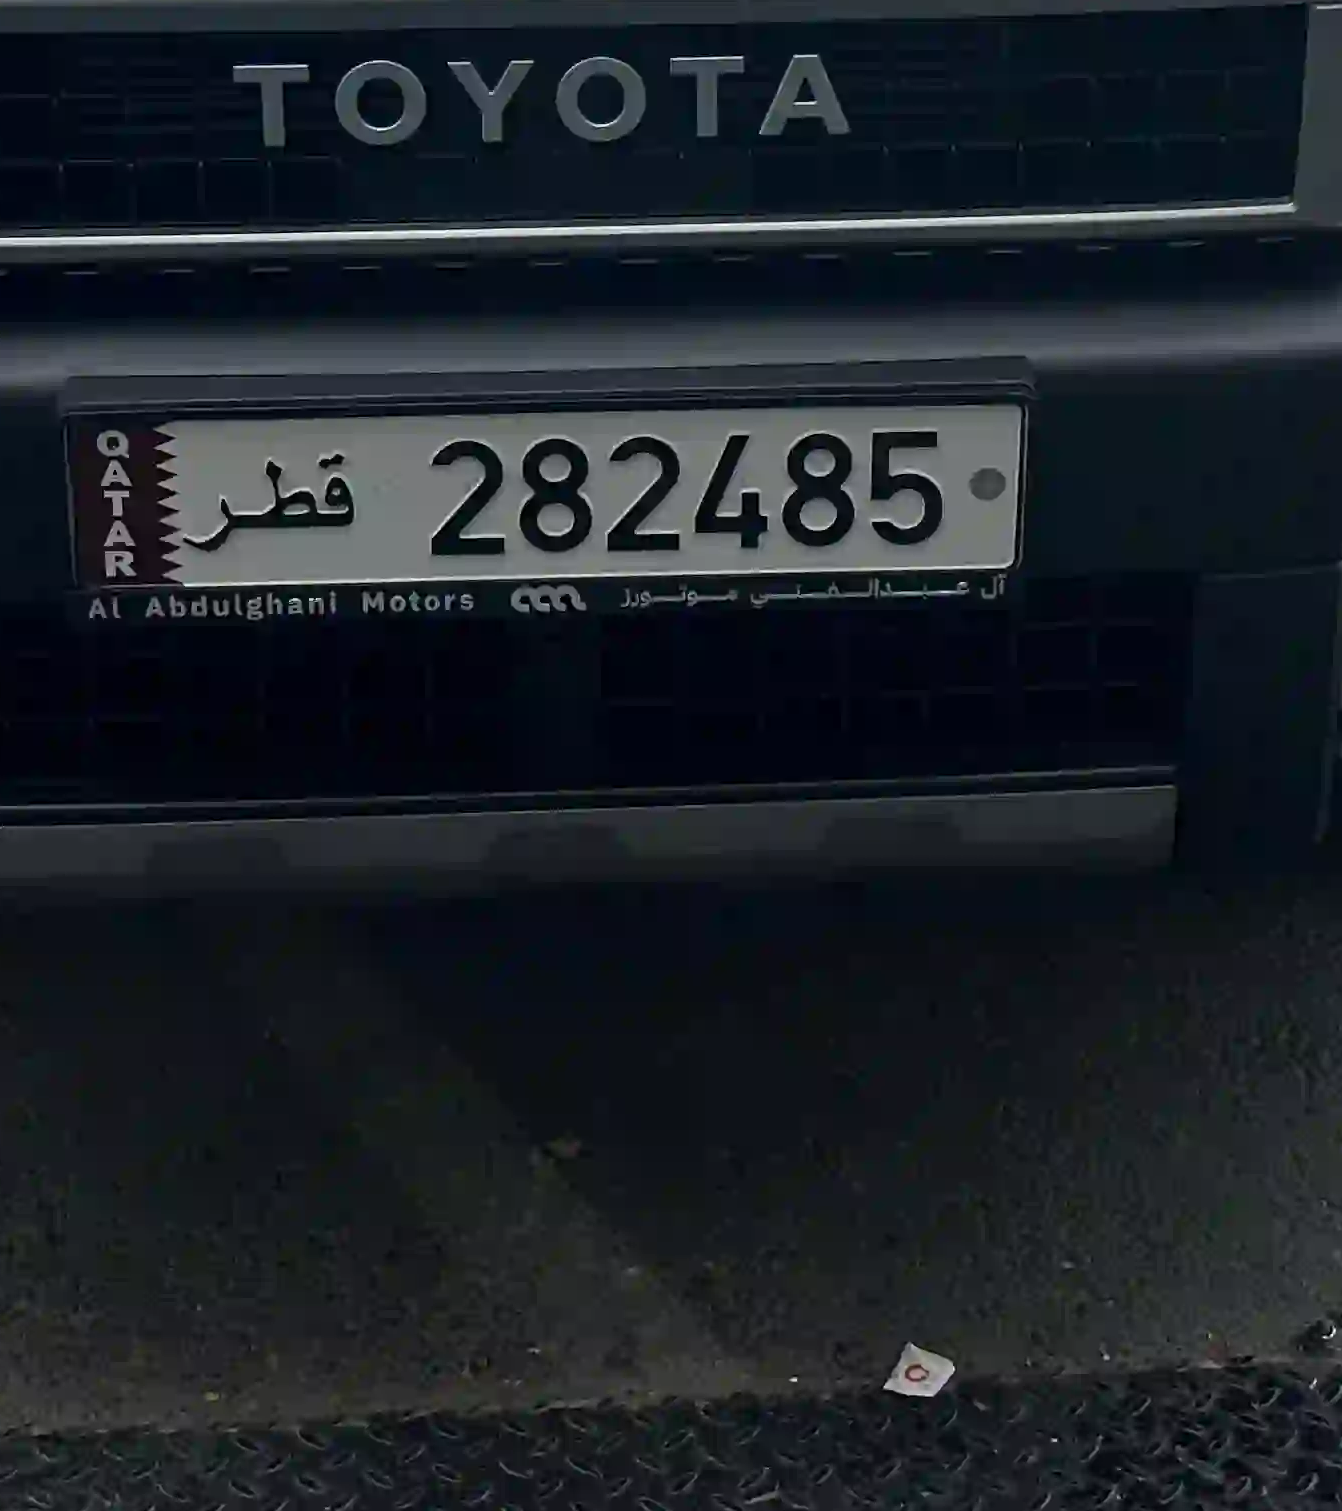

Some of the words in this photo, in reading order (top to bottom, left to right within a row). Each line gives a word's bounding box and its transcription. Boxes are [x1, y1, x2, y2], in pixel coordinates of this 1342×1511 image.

[232, 54, 851, 147] TOYOTA
[96, 430, 137, 577] QATAR
[182, 452, 354, 552] قطر
[429, 430, 944, 556] 282485
[88, 597, 121, 620] Al
[144, 590, 338, 621] Abdulghani
[361, 588, 475, 614] Motors
